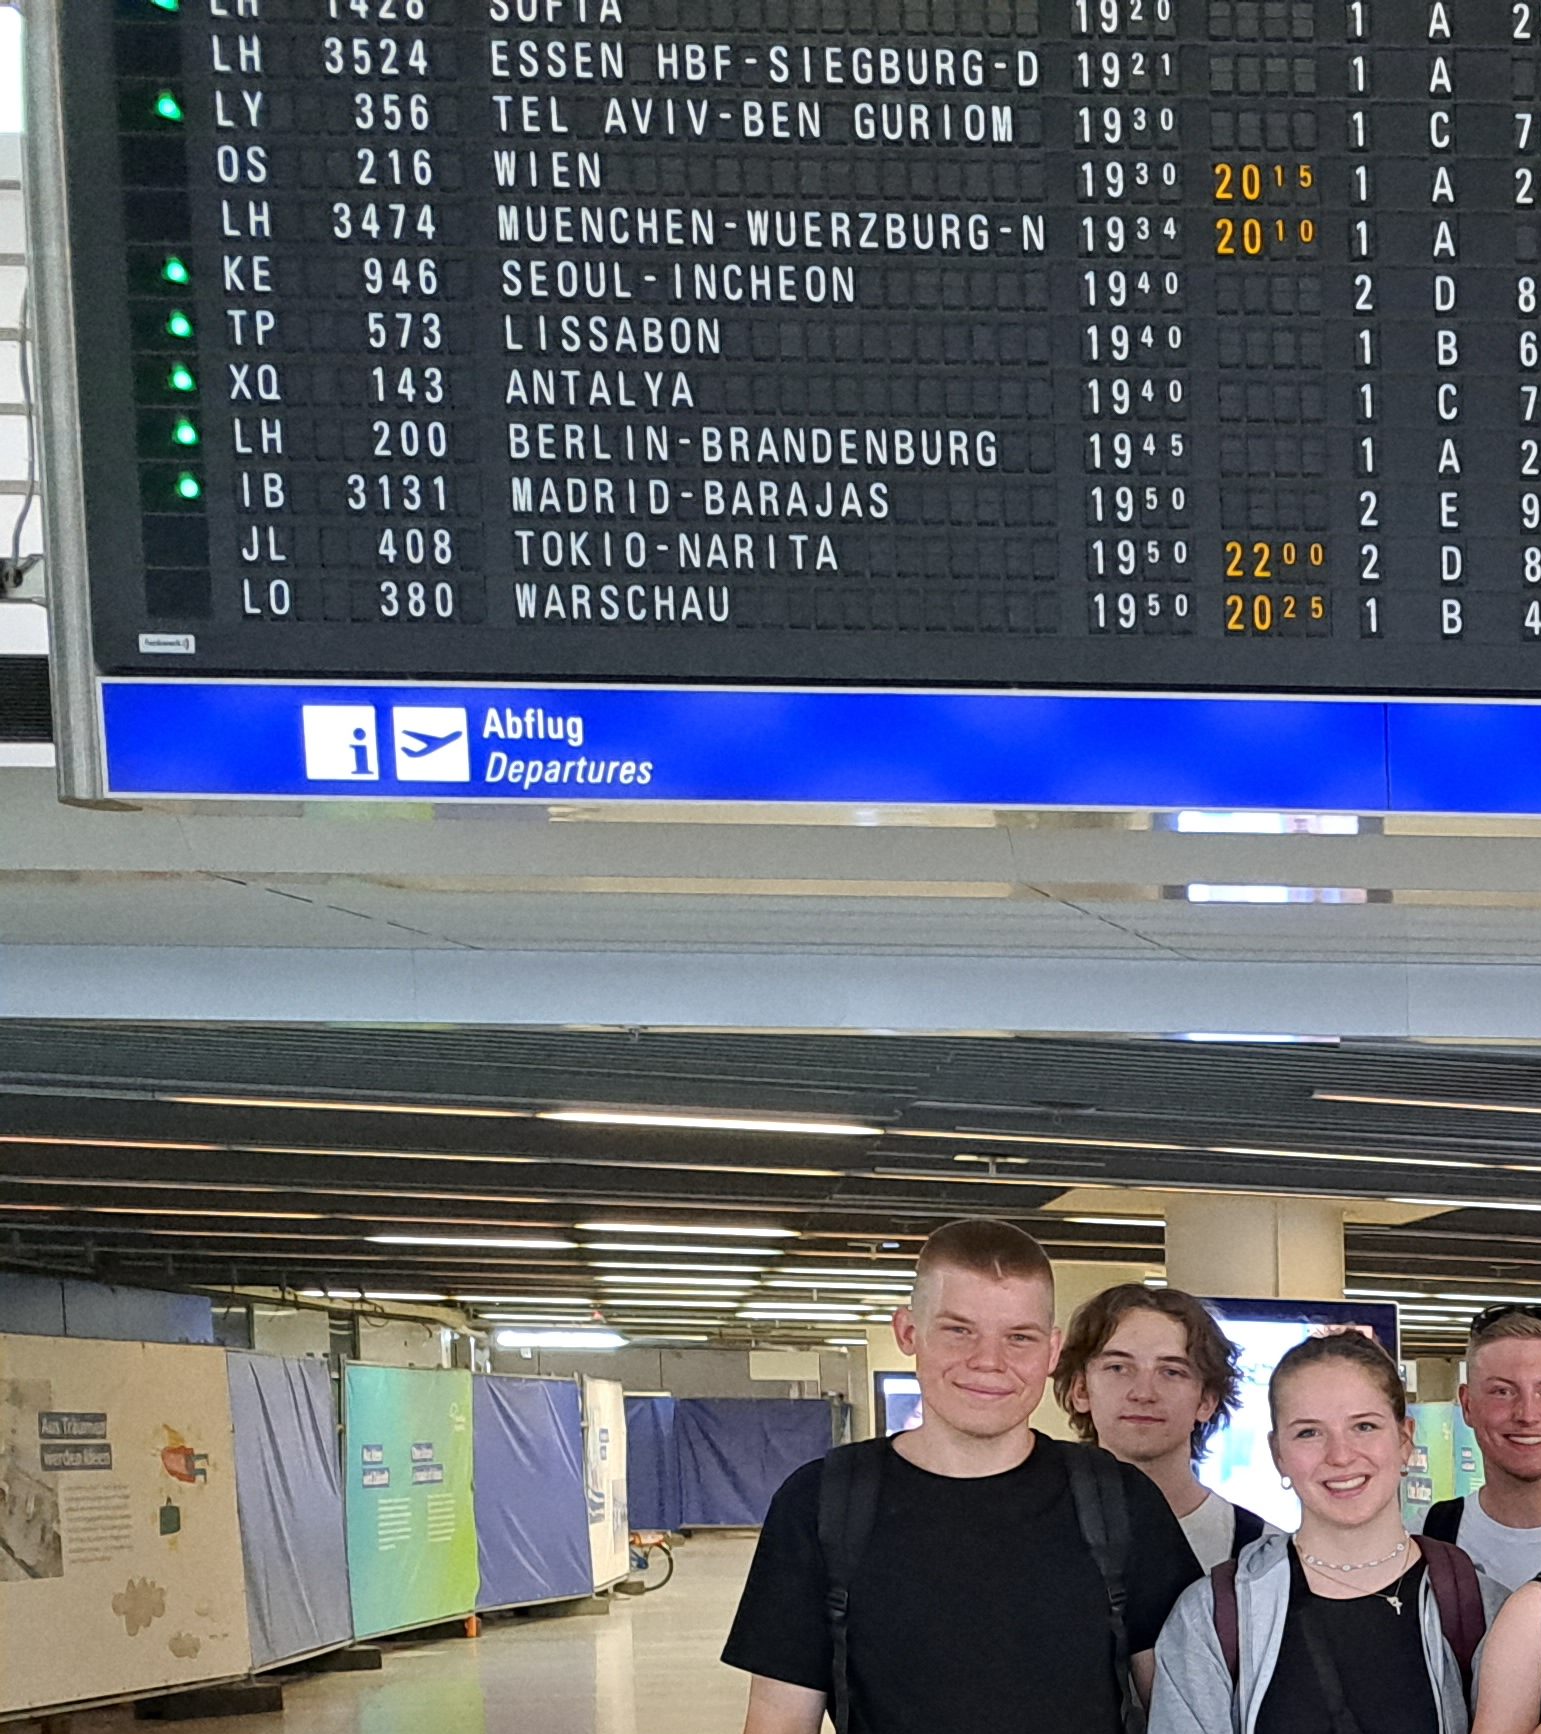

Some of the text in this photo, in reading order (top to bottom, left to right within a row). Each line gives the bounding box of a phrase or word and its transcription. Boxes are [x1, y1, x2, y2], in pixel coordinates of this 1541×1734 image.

[492, 40, 622, 78] ESSEN
[493, 96, 568, 132] TEL
[494, 151, 600, 187] WIEN
[506, 315, 719, 353] LISSABON
[506, 369, 693, 407] ANTALYA
[516, 584, 728, 621] WARSCHAU
[483, 708, 583, 746] Abflug
[486, 752, 652, 789] Departures
